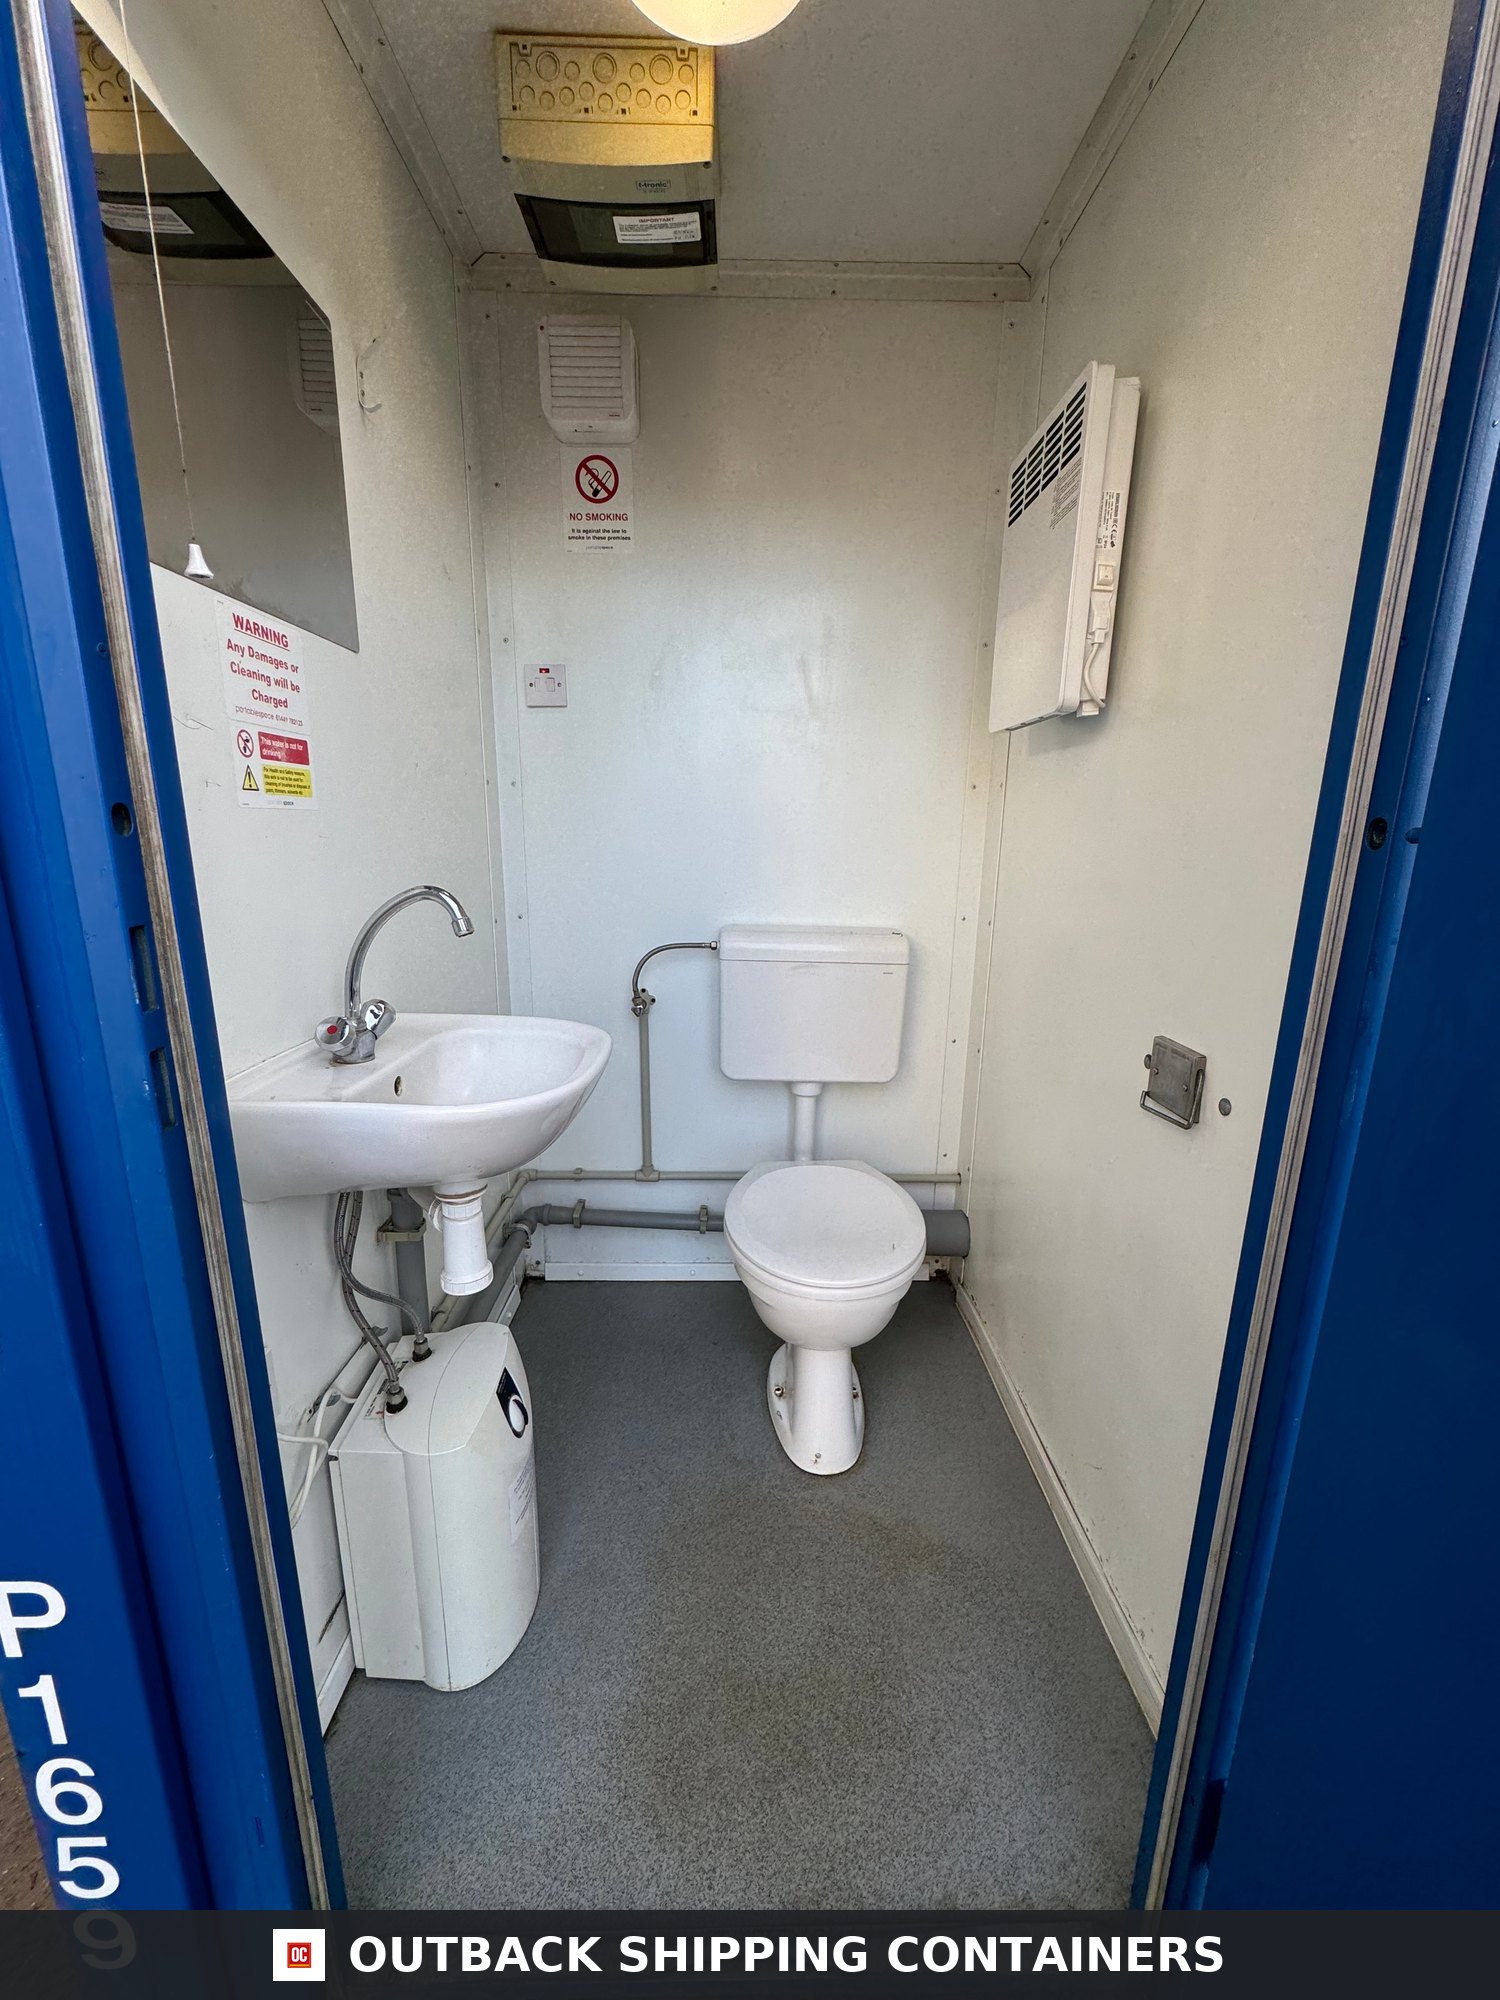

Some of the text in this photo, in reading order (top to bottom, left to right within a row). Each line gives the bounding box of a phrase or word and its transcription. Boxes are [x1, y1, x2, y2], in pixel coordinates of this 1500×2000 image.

[569, 513, 628, 521] NO SMOKING
[232, 612, 289, 648] WARNING
[227, 638, 299, 674] Any Damages or
[230, 661, 301, 693] Cleaning will be
[251, 688, 289, 709] Charged
[260, 736, 272, 746] This
[272, 740, 285, 748] water
[262, 748, 281, 760] drinking
